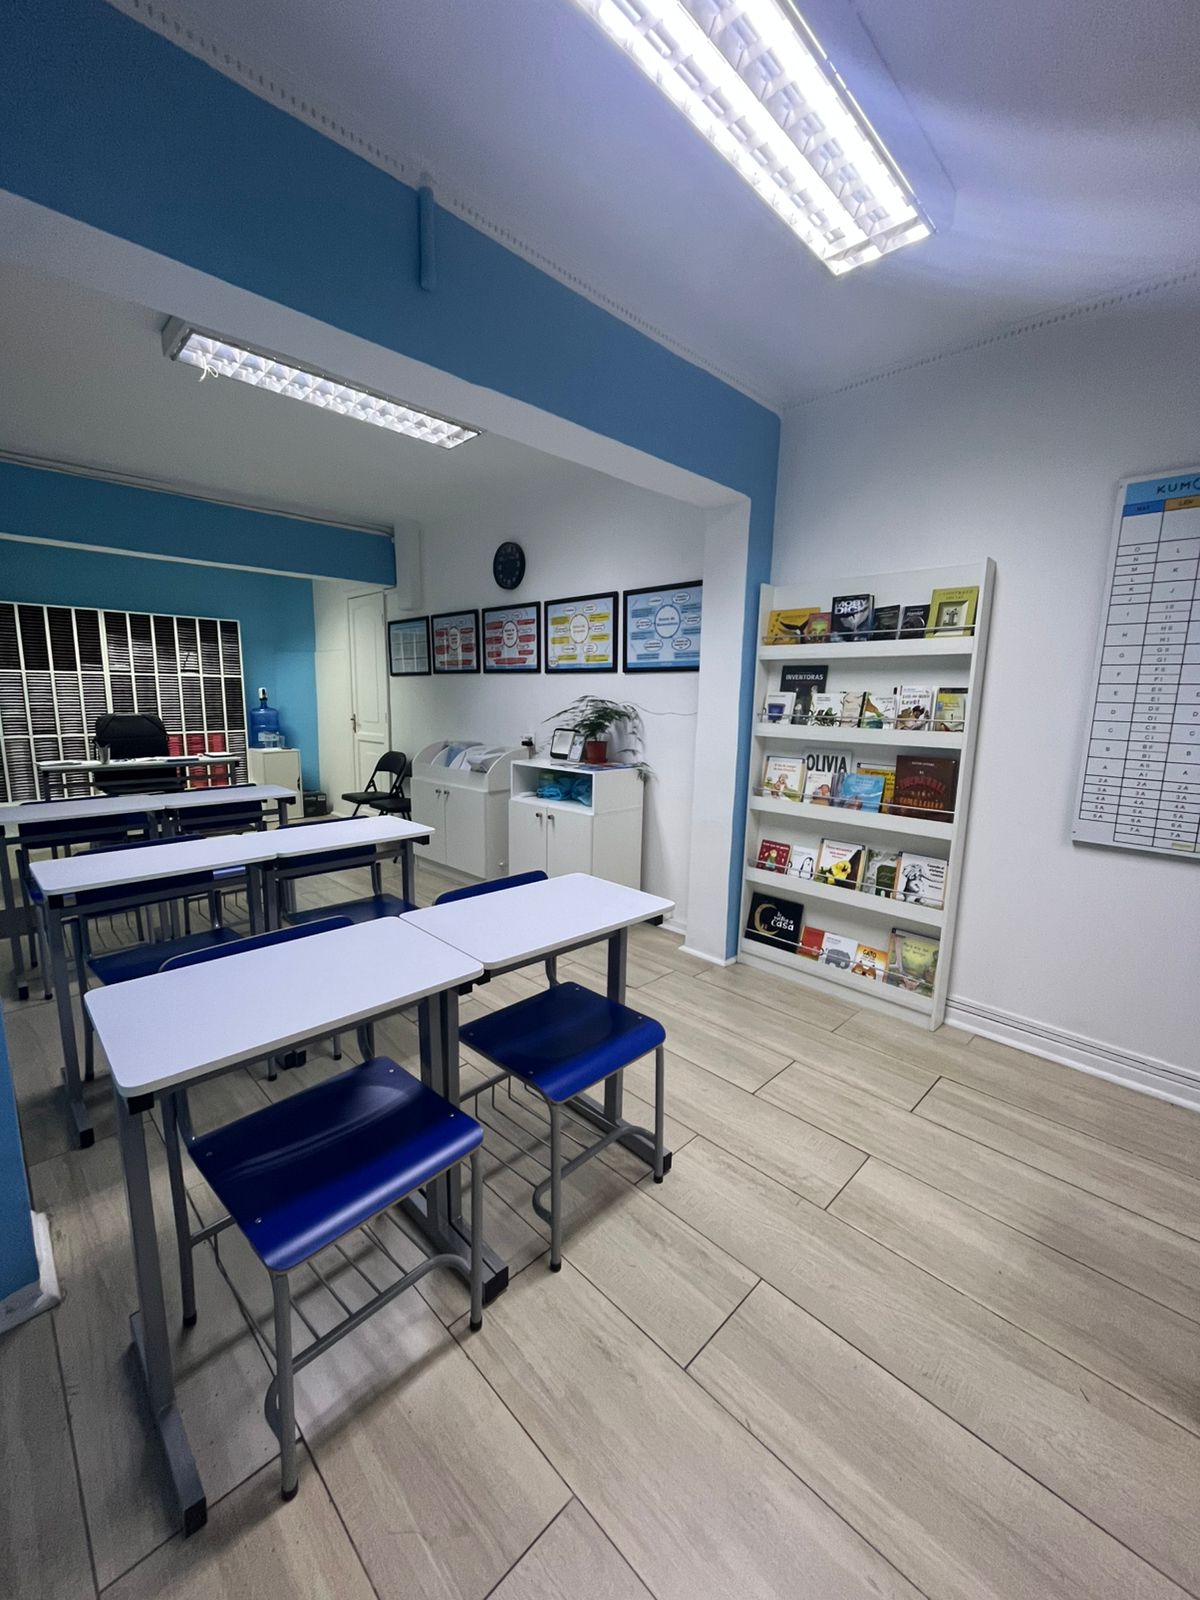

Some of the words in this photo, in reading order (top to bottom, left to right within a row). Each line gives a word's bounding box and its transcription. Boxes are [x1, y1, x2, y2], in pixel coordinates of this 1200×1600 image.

[834, 599, 868, 608] MOBY
[785, 673, 824, 681] INVENTORAS
[806, 754, 848, 773] OLIVIA
